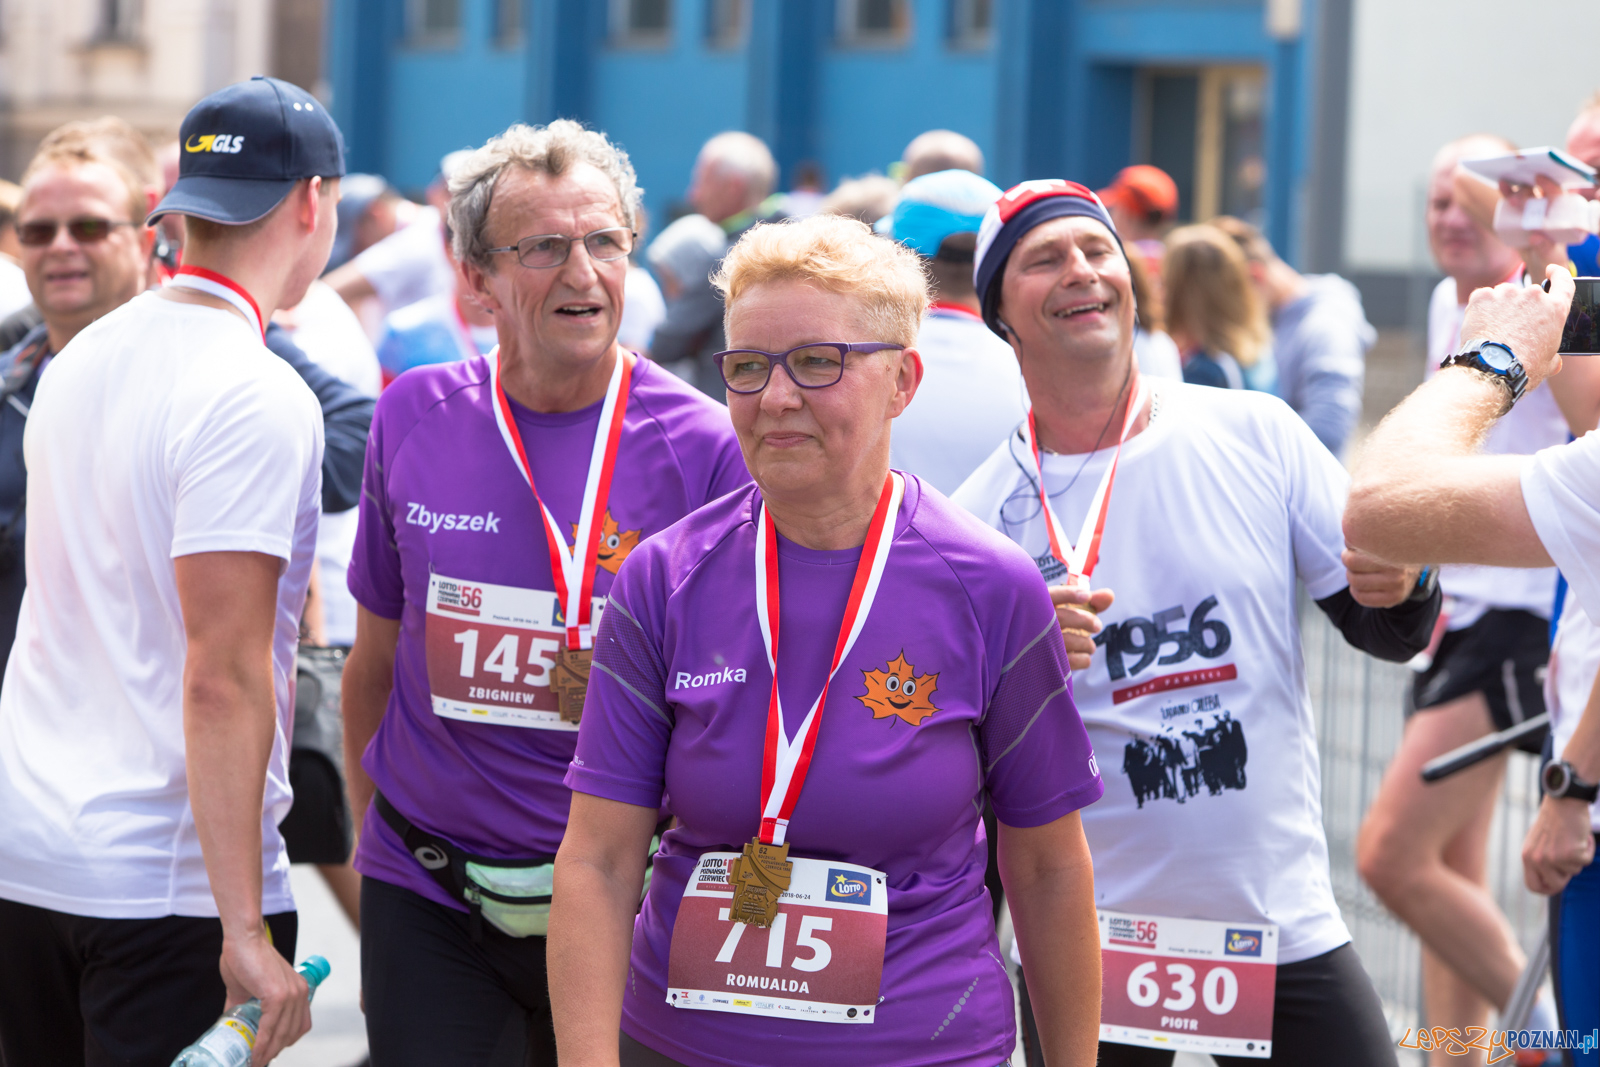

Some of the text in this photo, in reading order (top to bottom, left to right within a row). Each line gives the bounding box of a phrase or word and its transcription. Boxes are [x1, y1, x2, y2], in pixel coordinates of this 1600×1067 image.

[211, 134, 245, 154] GLS
[406, 502, 501, 534] Zbyszek
[438, 580, 458, 592] LOTTO
[1092, 594, 1232, 682] 1956
[453, 628, 560, 687] 145
[675, 667, 747, 689] Romka
[468, 686, 535, 705] ZBIGNIEW
[759, 847, 768, 855] 62
[702, 858, 723, 868] LOTTO
[699, 874, 726, 883] CZERWIEC
[838, 882, 861, 894] LOTTO
[781, 891, 811, 900] 2018-06-24
[714, 907, 833, 973] 715
[726, 973, 810, 994] ROMUALDA
[1126, 961, 1239, 1015] 630
[1161, 1016, 1199, 1031] PIOTR
